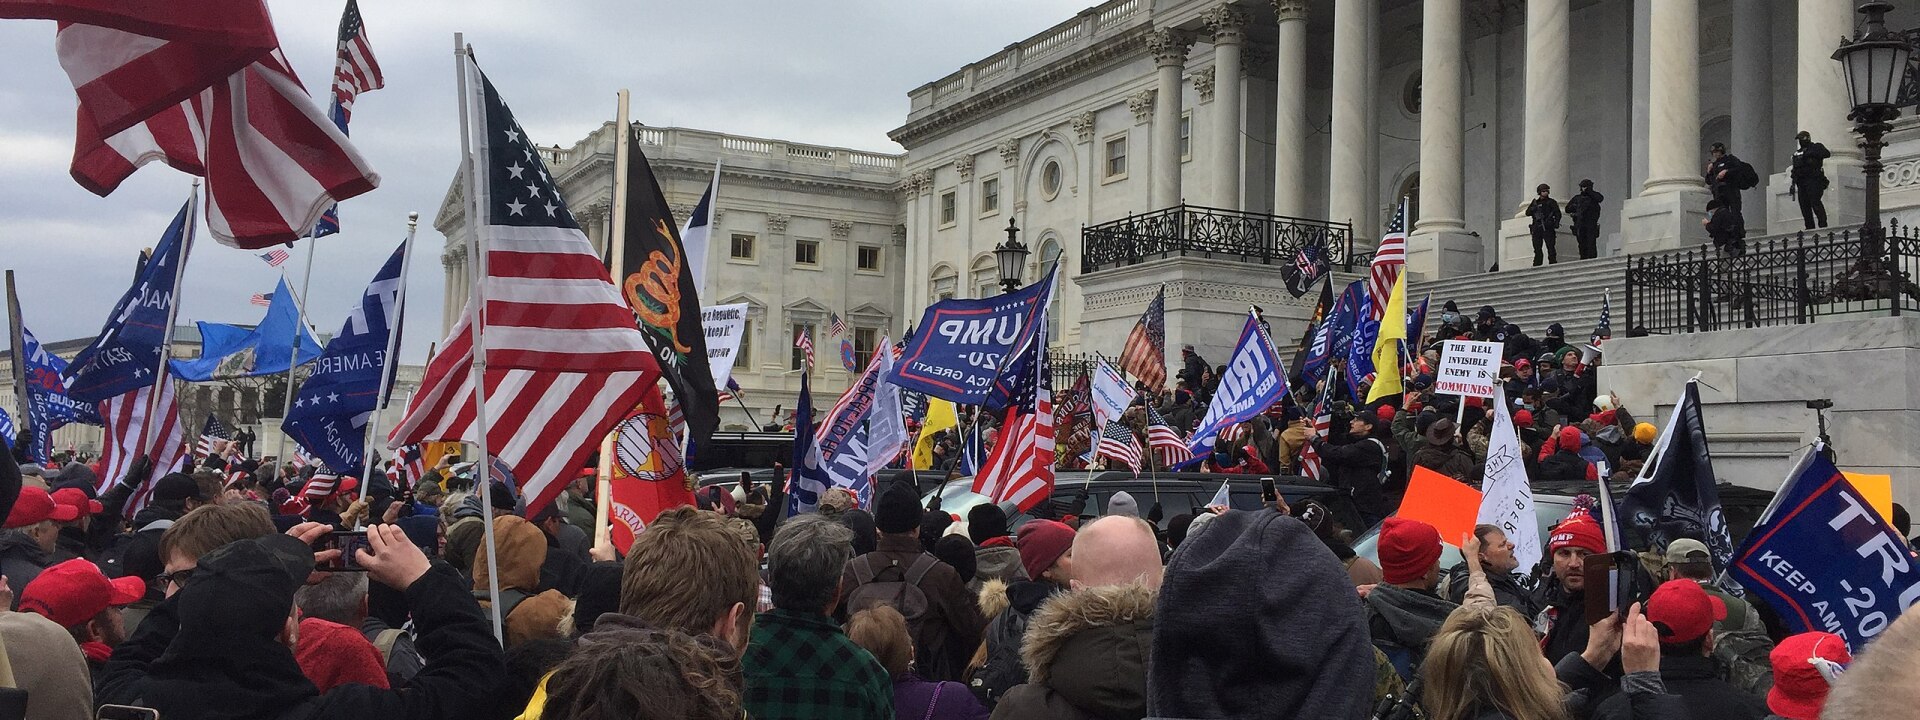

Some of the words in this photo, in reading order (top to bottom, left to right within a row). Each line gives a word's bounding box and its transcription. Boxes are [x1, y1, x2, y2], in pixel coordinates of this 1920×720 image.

[712, 308, 740, 321] Republic,
[707, 325, 723, 337] keep
[1450, 344, 1466, 352] THE
[1471, 345, 1493, 354] REAL
[1448, 356, 1488, 366] INVISIBLE
[1445, 368, 1471, 378] ENEMY
[1478, 370, 1486, 378] IS
[1436, 381, 1494, 395] COMMUNISM
[324, 420, 358, 468] AGAIN!
[1759, 550, 1817, 595] KEEP
[1840, 579, 1888, 638] -20
